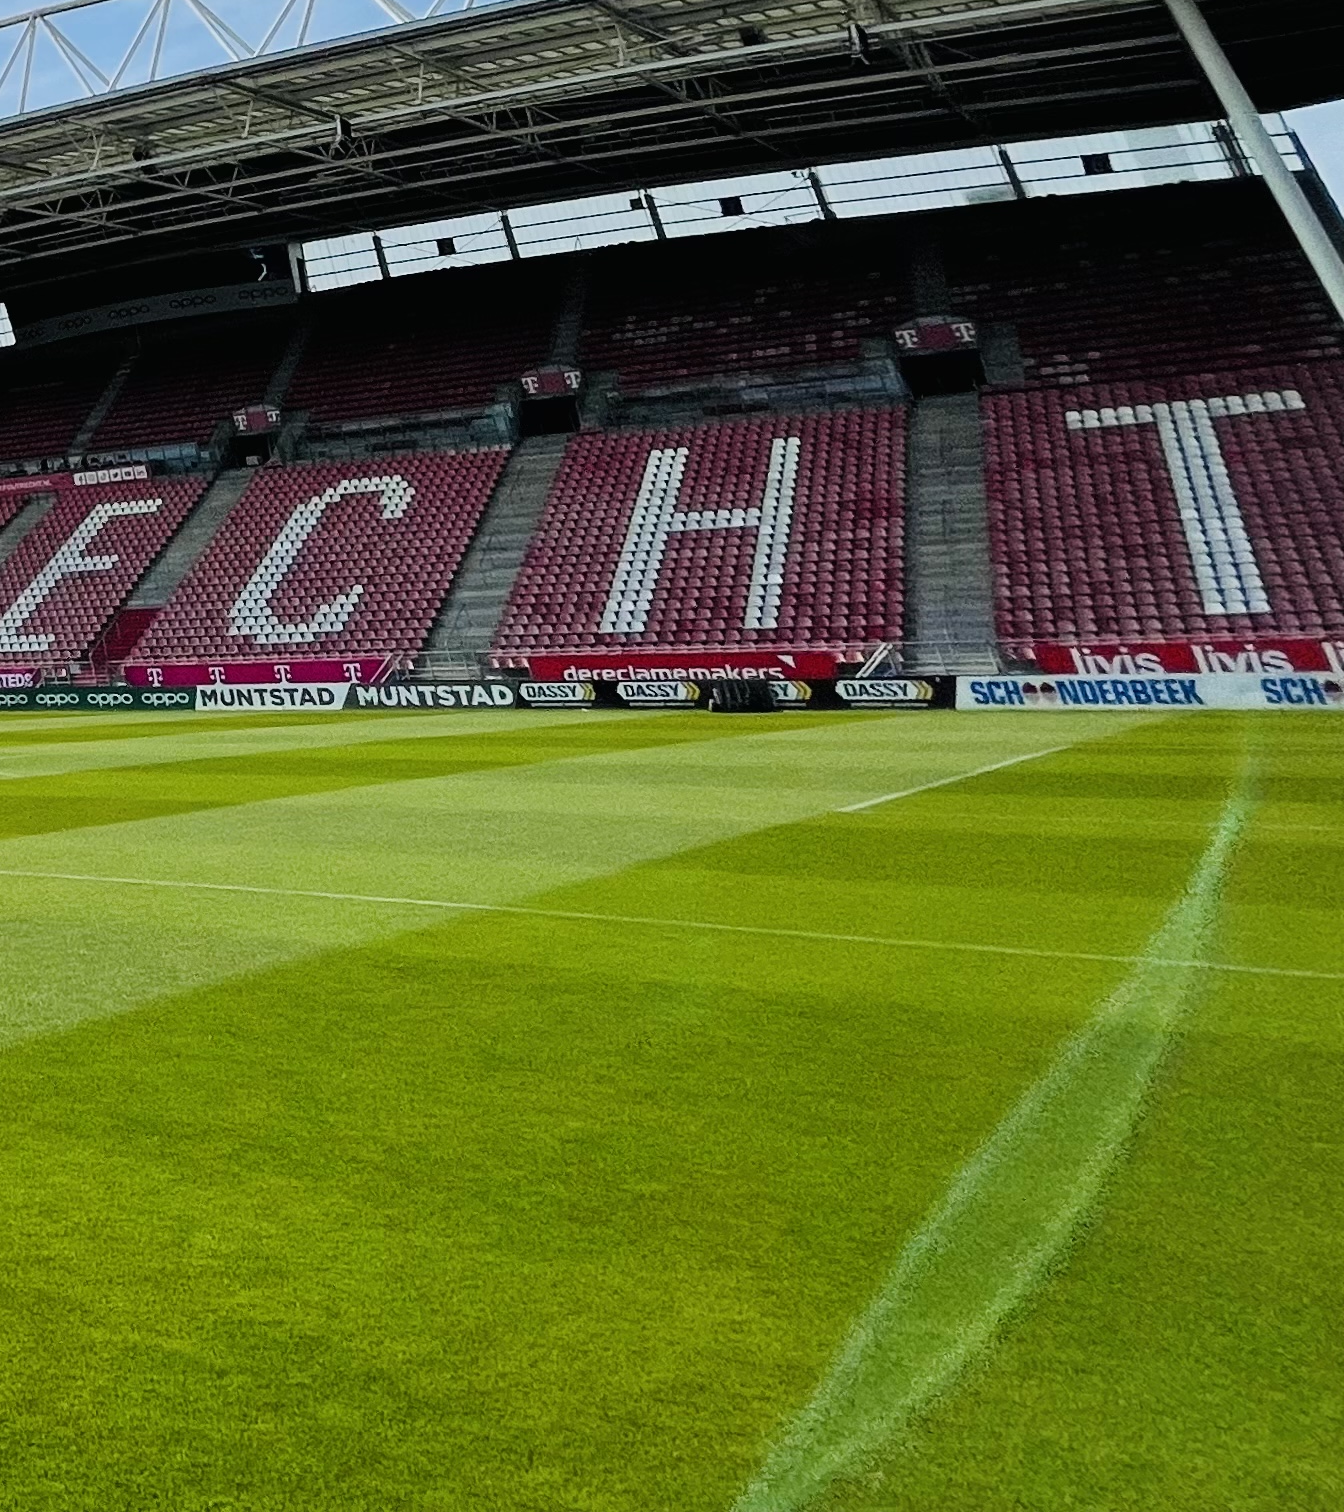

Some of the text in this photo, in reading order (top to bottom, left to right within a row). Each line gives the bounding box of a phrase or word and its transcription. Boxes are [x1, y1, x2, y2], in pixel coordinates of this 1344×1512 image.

[201, 687, 336, 707] MUNTSTAD
[359, 684, 514, 708] MUNTSTAD
[526, 684, 580, 699] DASSY
[625, 683, 680, 697] DASSY
[844, 682, 909, 698] DASSY
[36, 693, 80, 707] oppo
[87, 693, 134, 708] oppo
[141, 692, 189, 706] oppo
